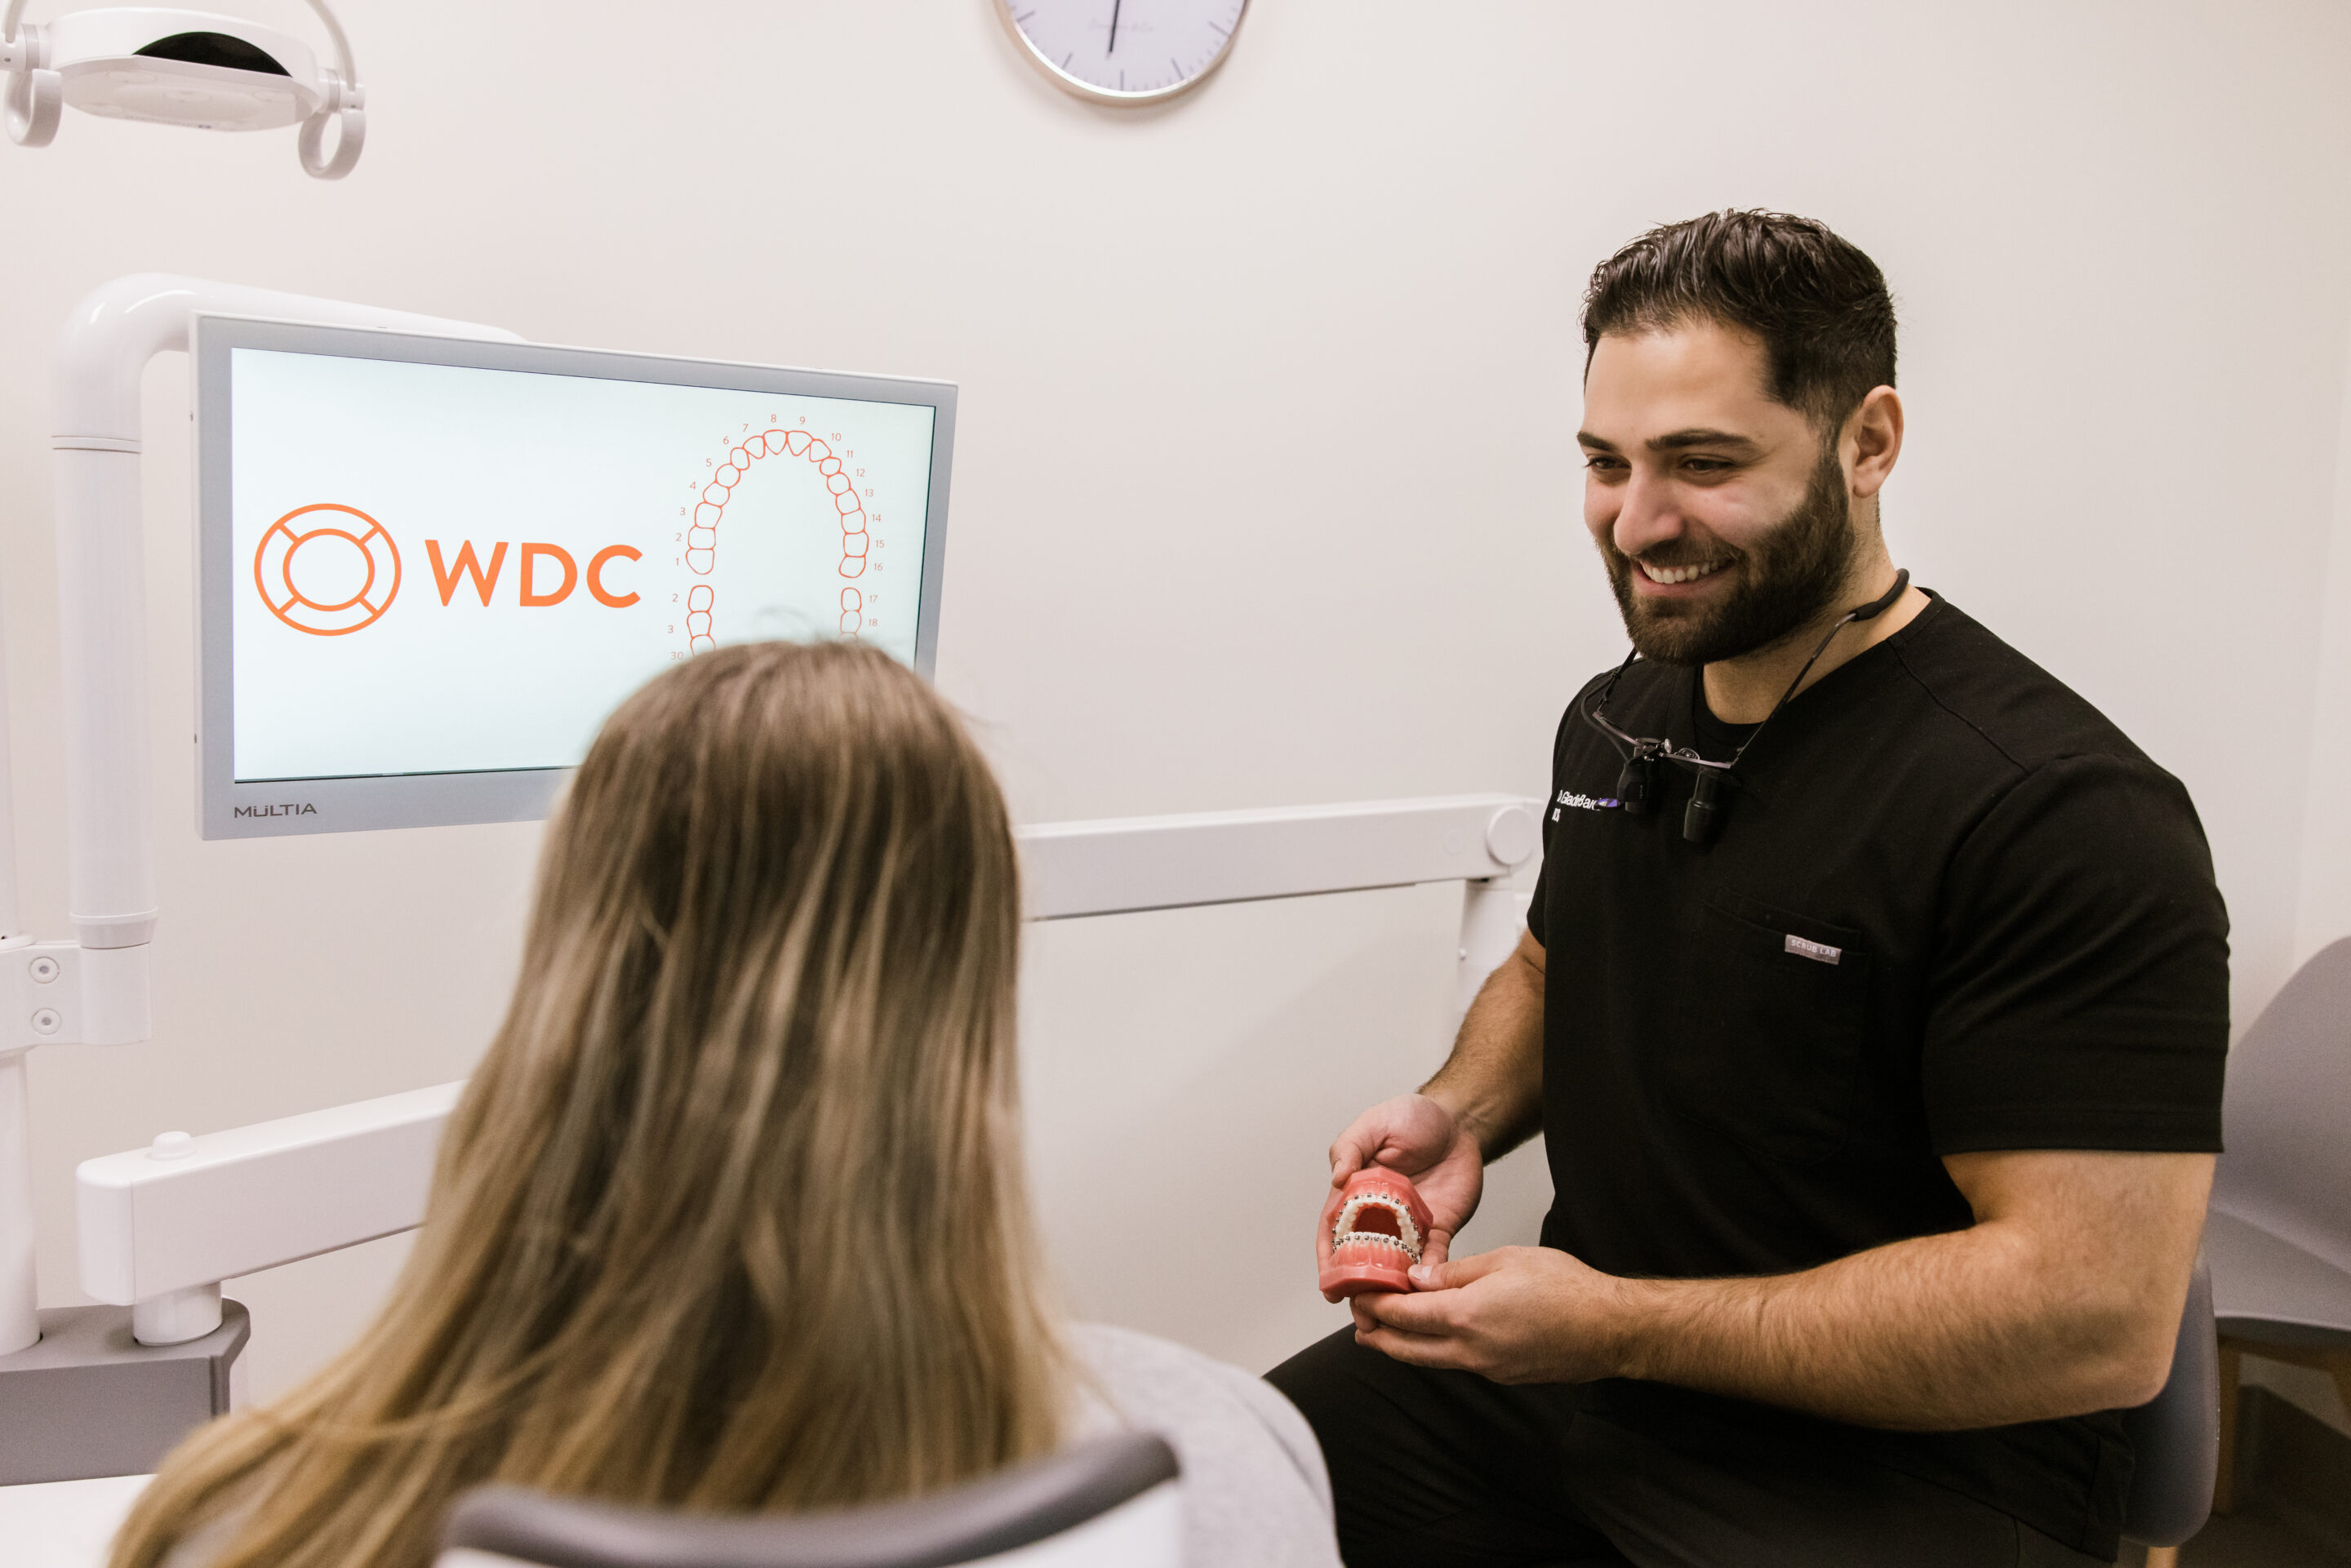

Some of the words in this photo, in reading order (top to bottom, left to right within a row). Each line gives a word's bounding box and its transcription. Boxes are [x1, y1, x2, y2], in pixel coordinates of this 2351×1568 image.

[771, 414, 777, 424] 8
[799, 415, 806, 424] 9
[742, 424, 749, 433] 7
[722, 436, 730, 445] 6
[831, 433, 842, 442] 10
[847, 450, 854, 459] 11
[706, 458, 712, 467] 5
[856, 469, 865, 478] 12
[689, 482, 696, 490] 4
[864, 489, 874, 497] 13
[680, 507, 686, 517] 3
[872, 513, 882, 522] 14
[676, 532, 682, 542] 2
[875, 540, 885, 549] 15
[873, 563, 883, 571] 16
[424, 539, 643, 609] WDC
[672, 593, 678, 603] 2
[869, 594, 878, 603] 17
[869, 618, 878, 627] 18
[668, 624, 673, 634] 3
[1791, 939, 1818, 953] SCRUB
[1820, 947, 1837, 957] LAB
